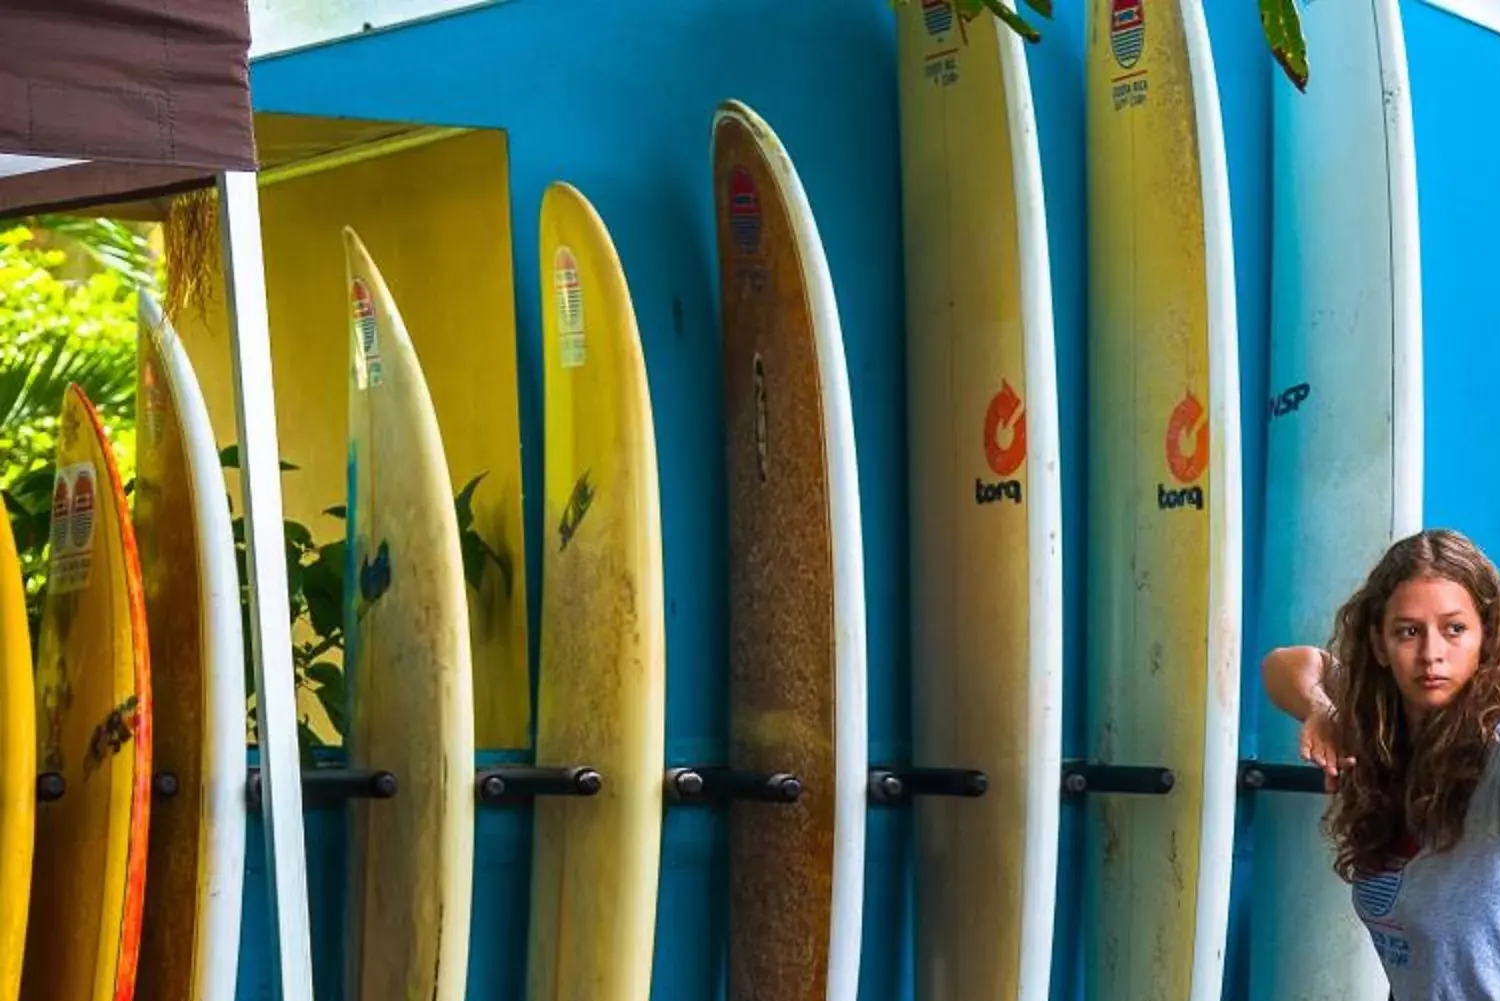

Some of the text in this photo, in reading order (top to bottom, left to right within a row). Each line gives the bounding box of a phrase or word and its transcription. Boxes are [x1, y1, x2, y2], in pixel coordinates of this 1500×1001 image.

[1269, 384, 1311, 419] NSP
[975, 478, 1022, 505] torq
[1158, 484, 1204, 511] torq
